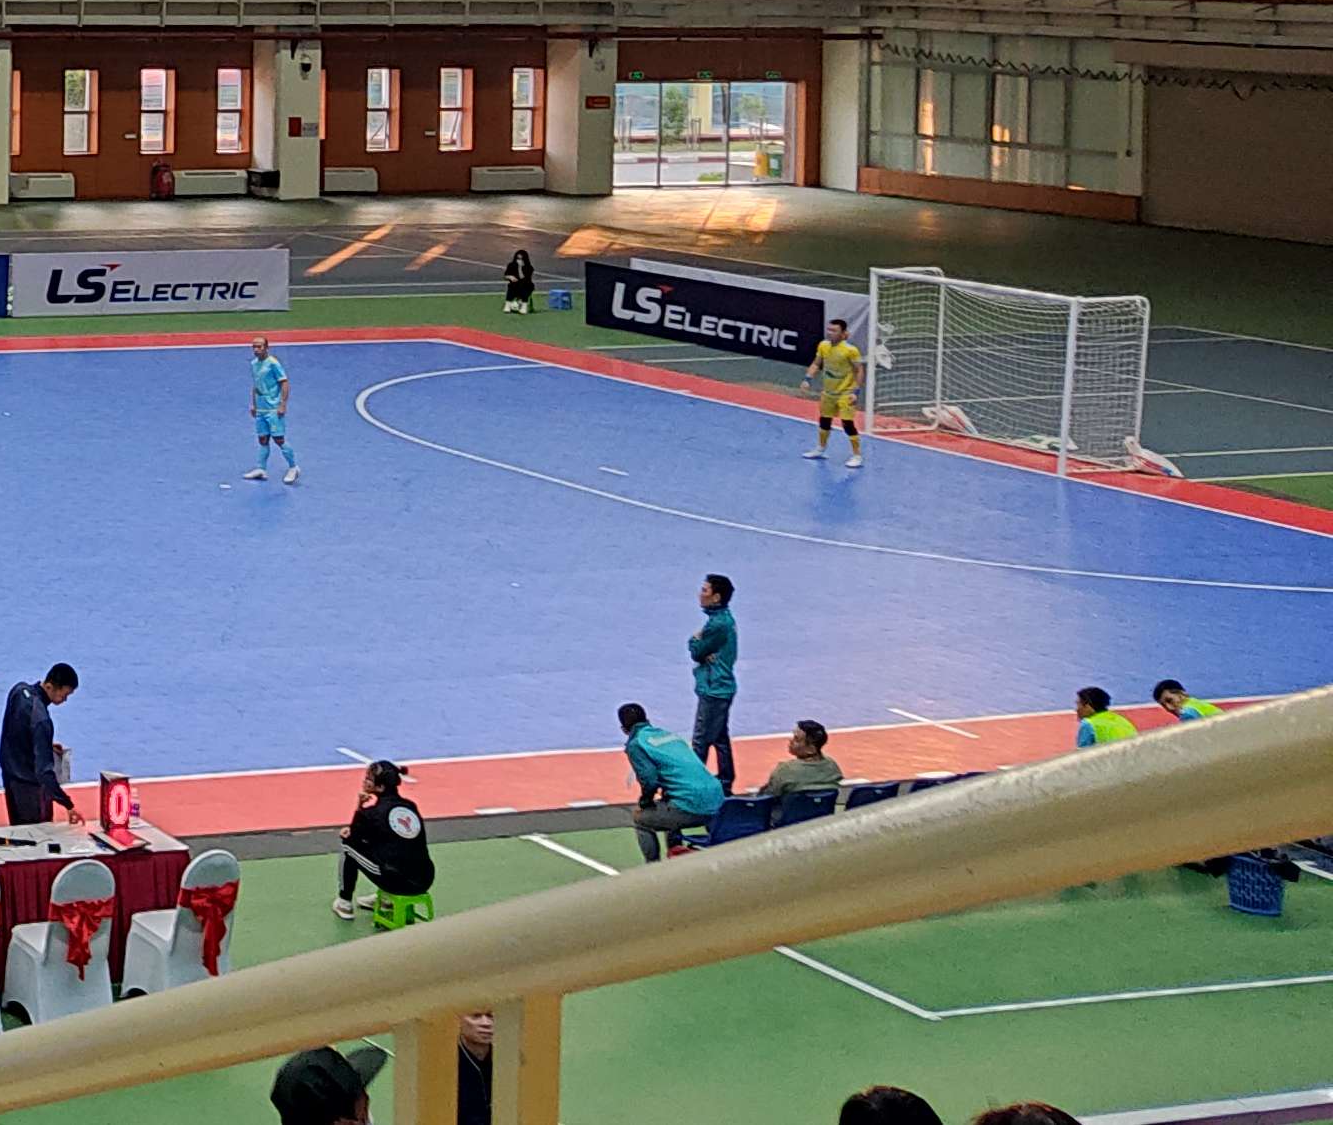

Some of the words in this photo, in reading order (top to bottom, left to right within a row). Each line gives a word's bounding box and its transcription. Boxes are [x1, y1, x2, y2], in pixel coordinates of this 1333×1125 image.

[47, 268, 108, 304] LS
[109, 280, 259, 303] ELECTRIC
[611, 271, 663, 325] LS
[662, 304, 799, 352] ELECTRIC
[108, 783, 129, 825] 0
